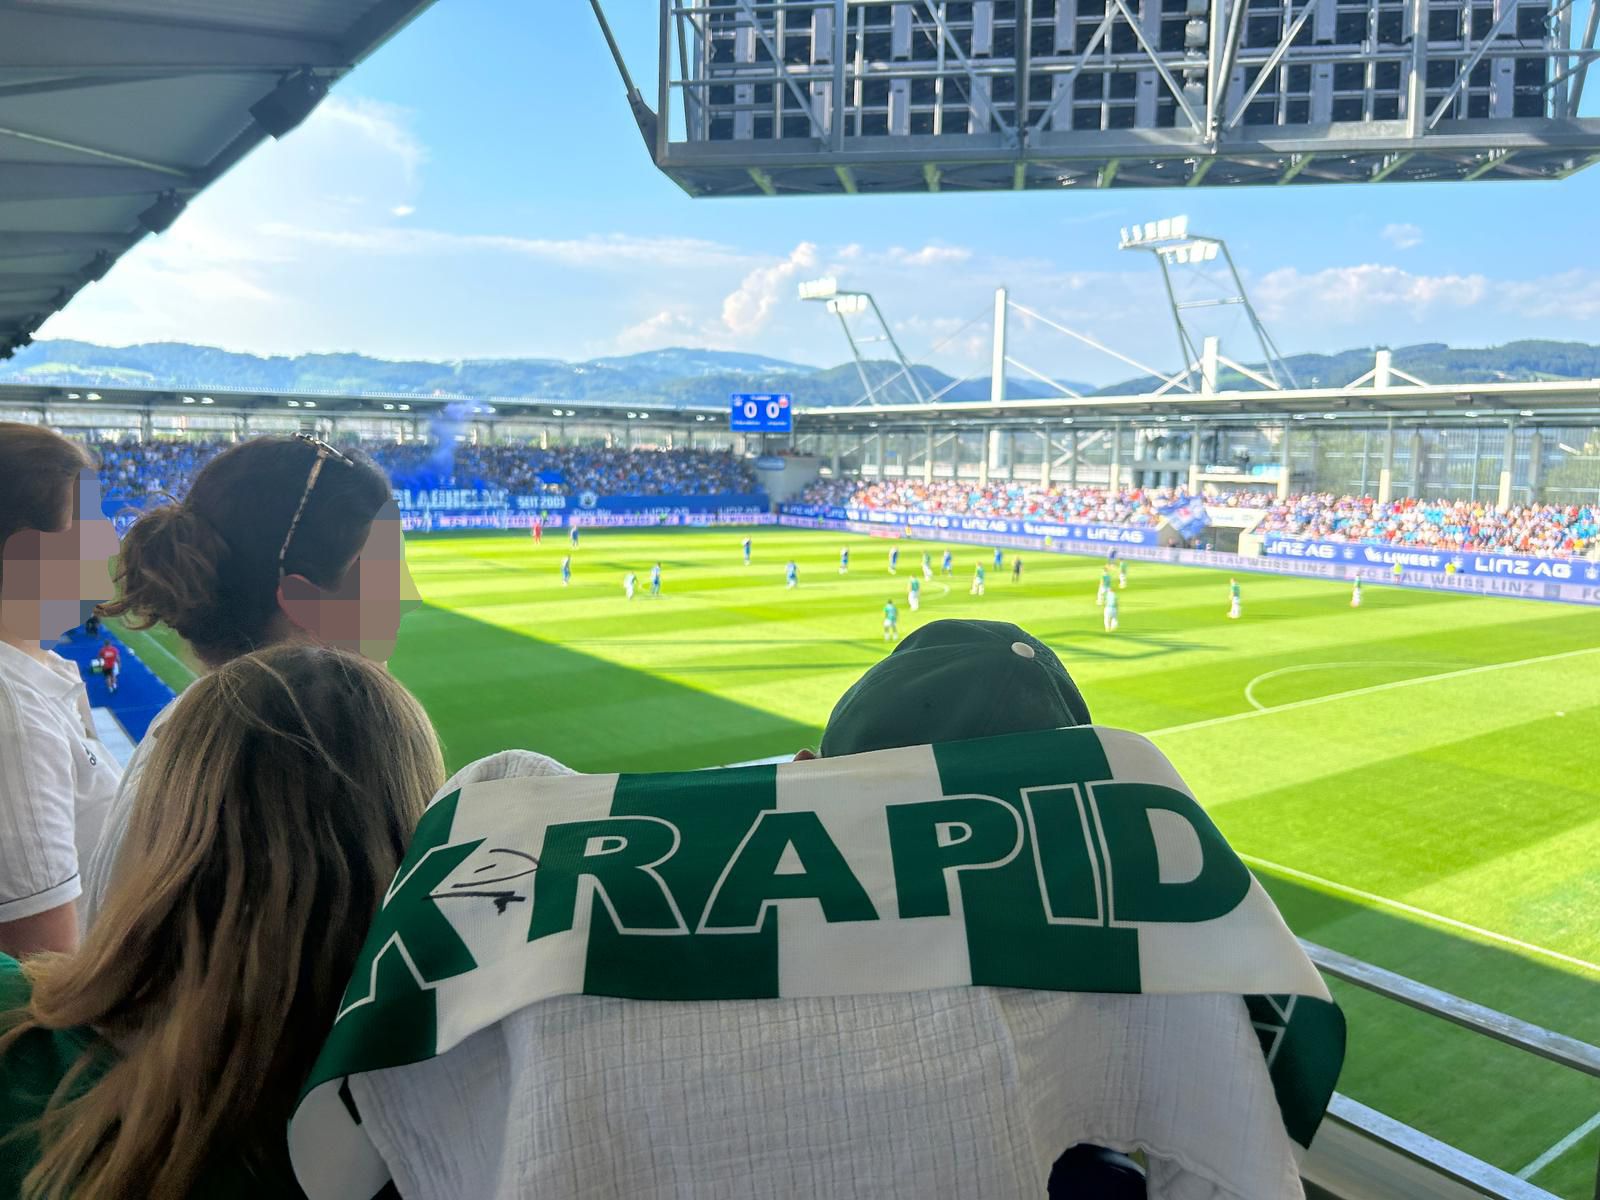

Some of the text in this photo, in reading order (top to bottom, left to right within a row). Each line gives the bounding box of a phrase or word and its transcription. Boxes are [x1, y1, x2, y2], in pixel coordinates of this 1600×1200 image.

[744, 401, 780, 418] 0 0
[1087, 527, 1144, 543] LINZ AG
[1304, 544, 1335, 559] AG
[1383, 552, 1440, 568] LIWEST
[1475, 557, 1572, 579] LINZ AG
[1383, 571, 1425, 582] BAU
[1431, 574, 1486, 588] WEISS
[1492, 580, 1535, 594] LINZ
[525, 779, 1253, 944] RAPID
